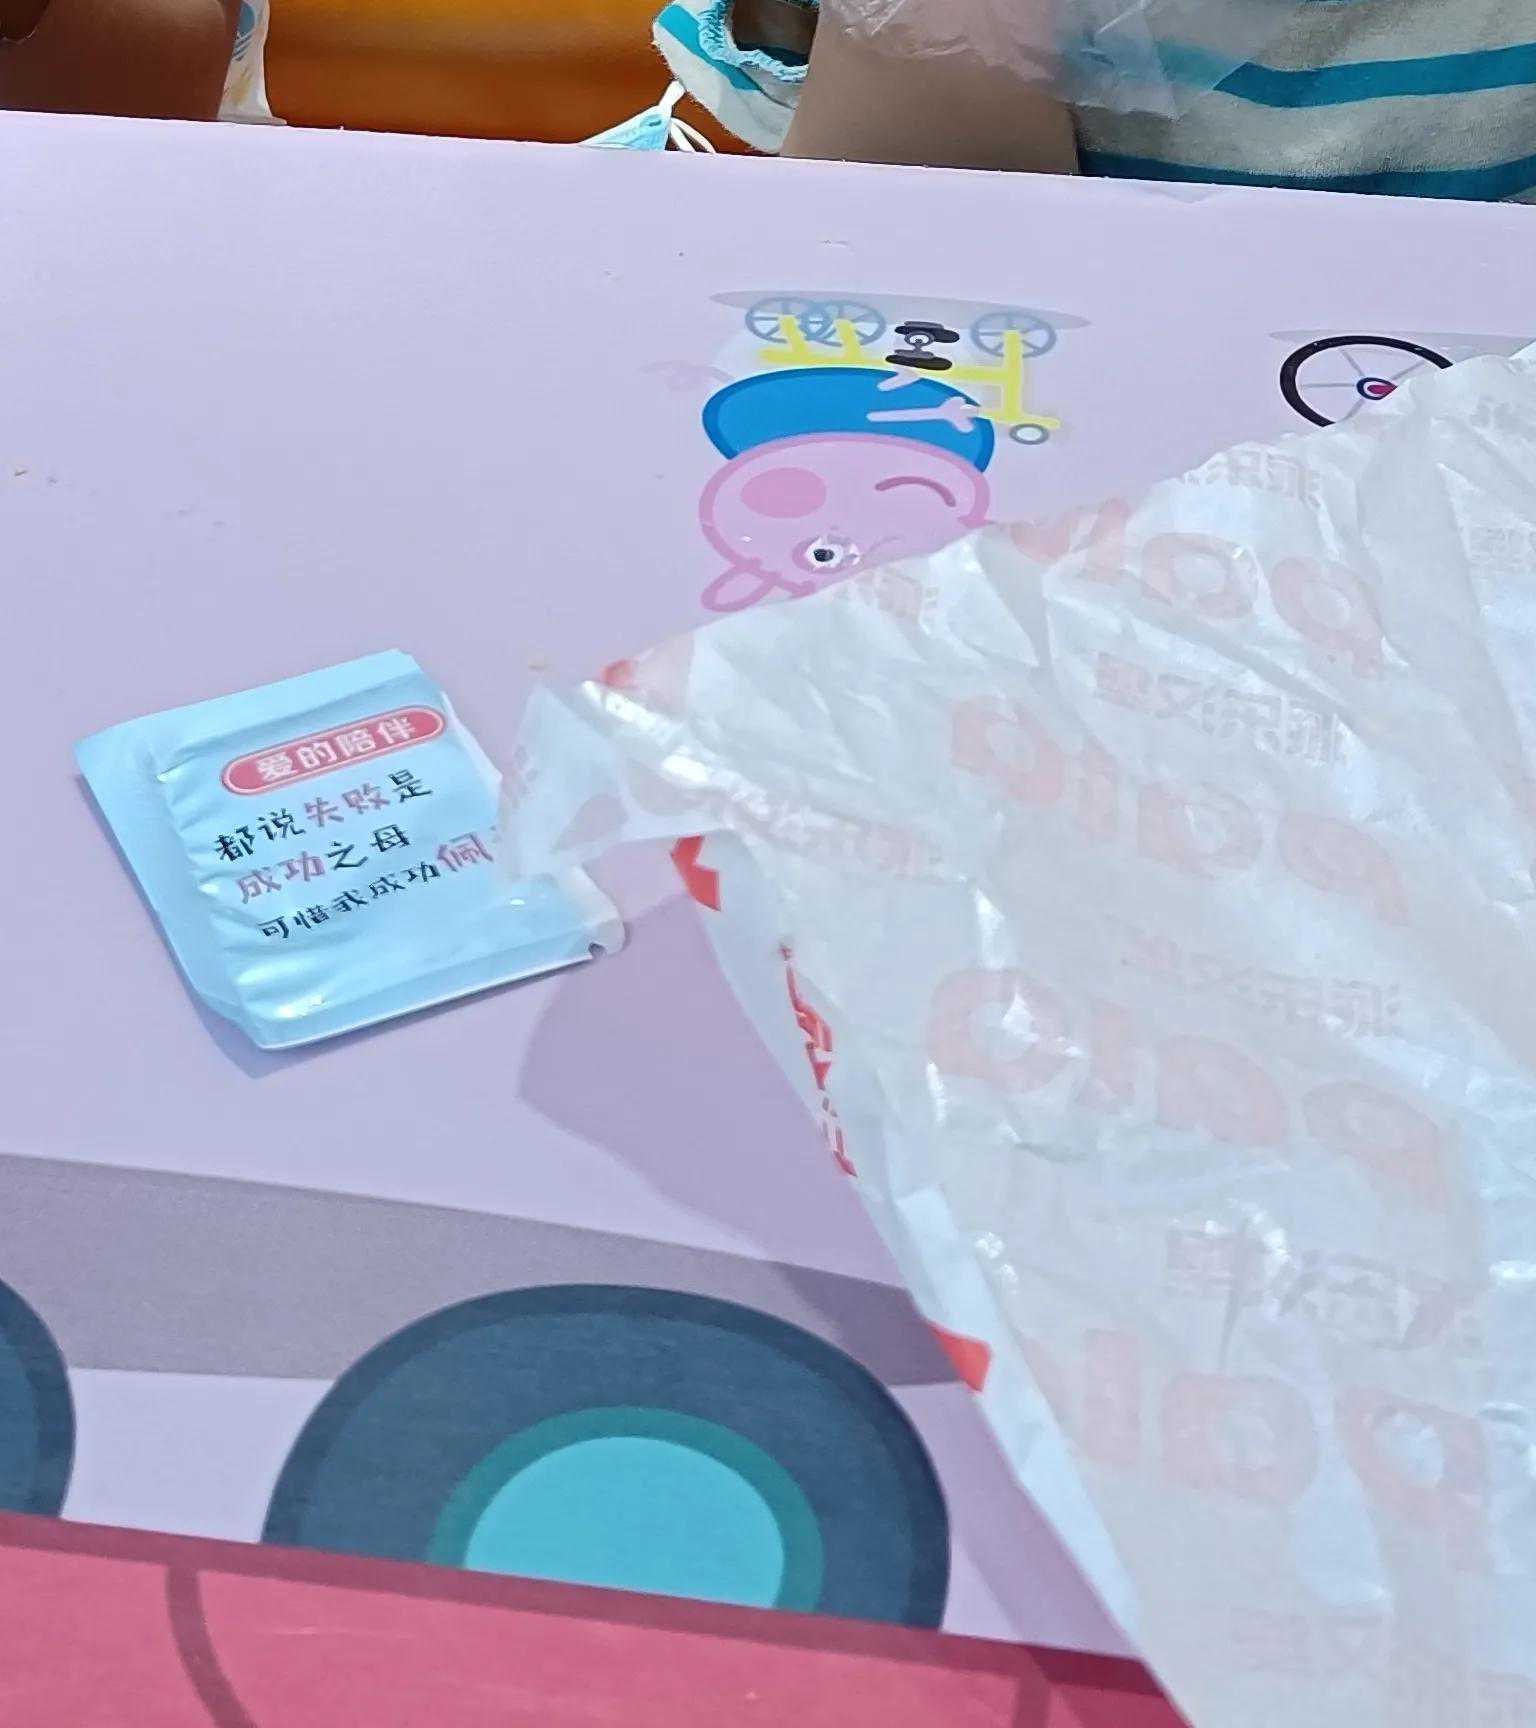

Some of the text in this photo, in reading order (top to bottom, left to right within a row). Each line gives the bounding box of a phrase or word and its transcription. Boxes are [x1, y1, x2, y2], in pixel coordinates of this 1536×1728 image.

[256, 716, 417, 781] 爱的陪伴
[215, 769, 433, 861] 都说失败是
[236, 824, 411, 903] 成功之母
